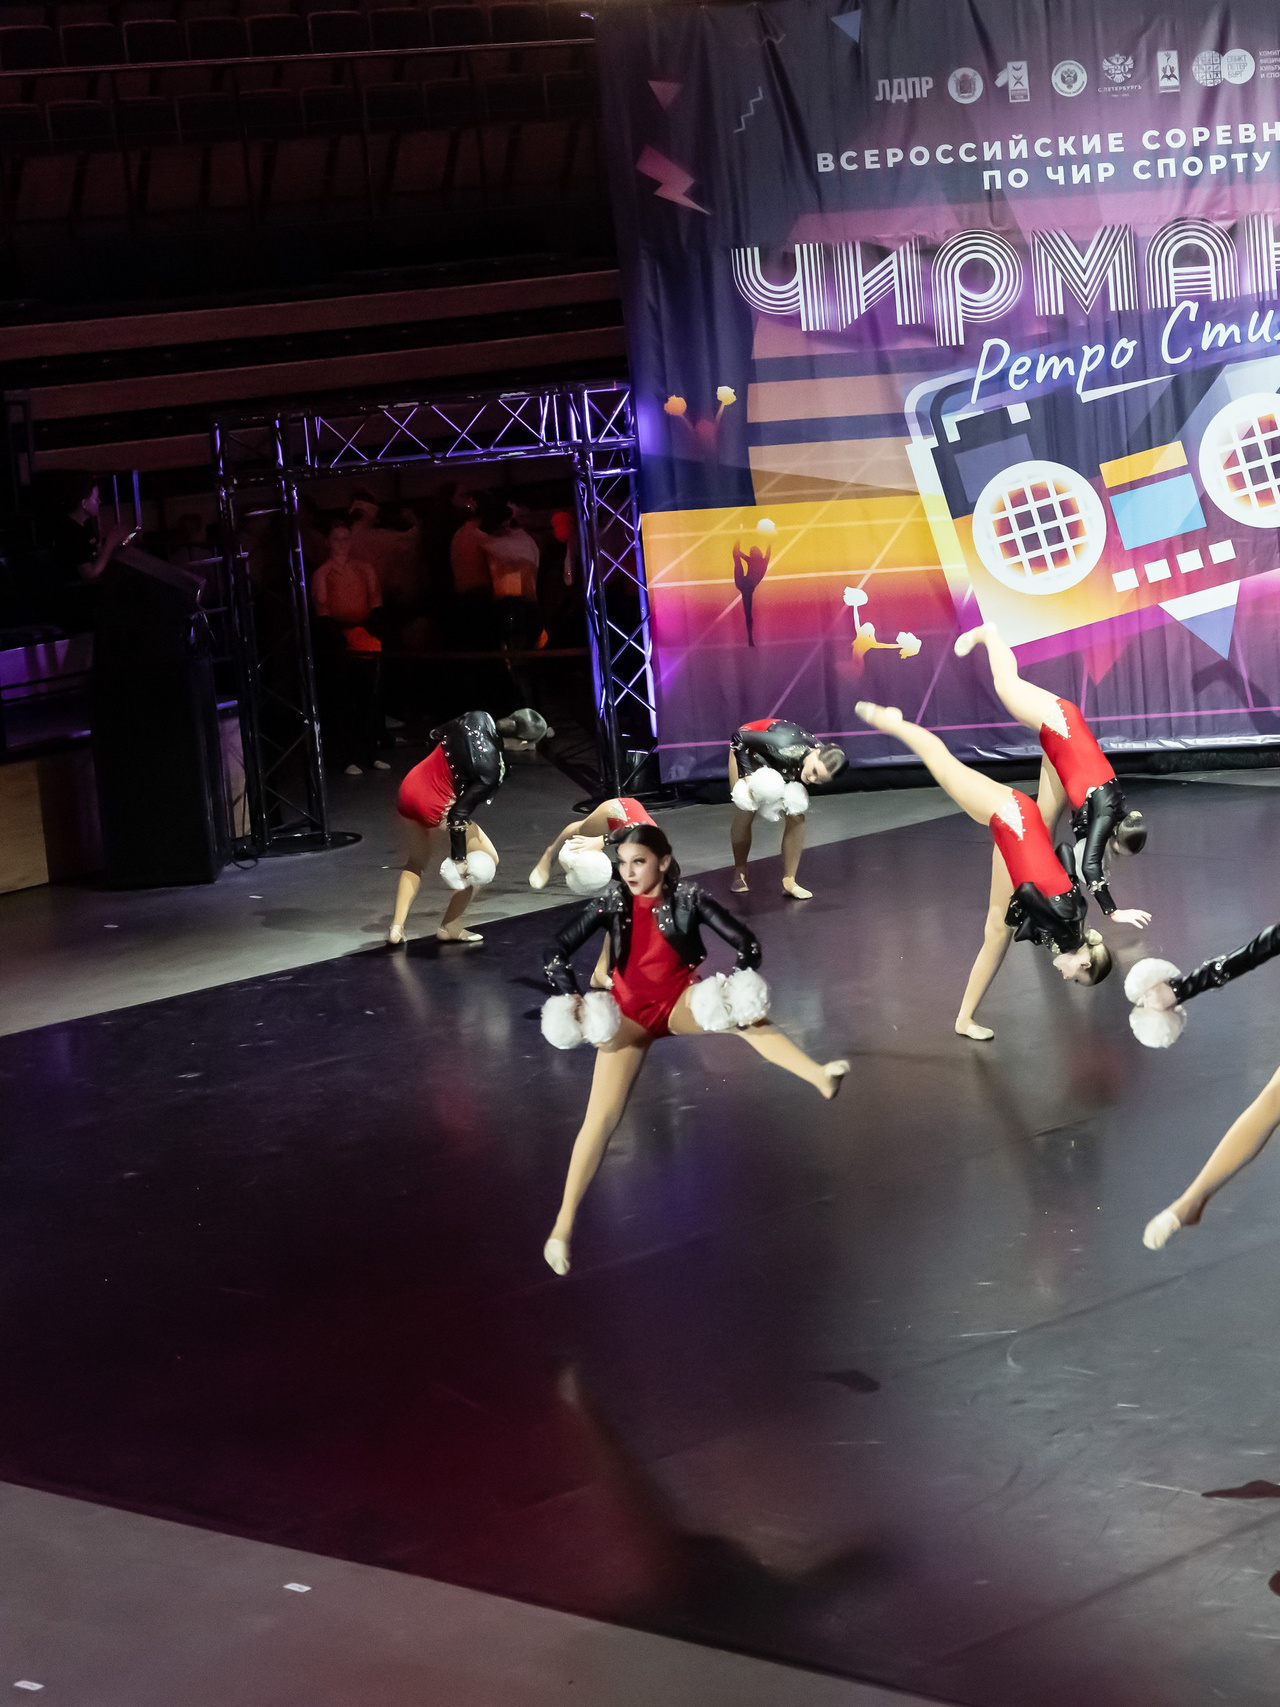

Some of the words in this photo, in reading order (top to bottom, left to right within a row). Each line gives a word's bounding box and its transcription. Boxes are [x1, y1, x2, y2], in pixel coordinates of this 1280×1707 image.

[875, 76, 934, 103] ЛДПР
[816, 132, 1125, 173] ВСЕРОССИЙСКИЕ
[982, 168, 1029, 190] ПО
[1046, 162, 1116, 186] ЧИР
[1132, 151, 1272, 181] СПОРТУ
[971, 337, 1137, 404] Ретро
